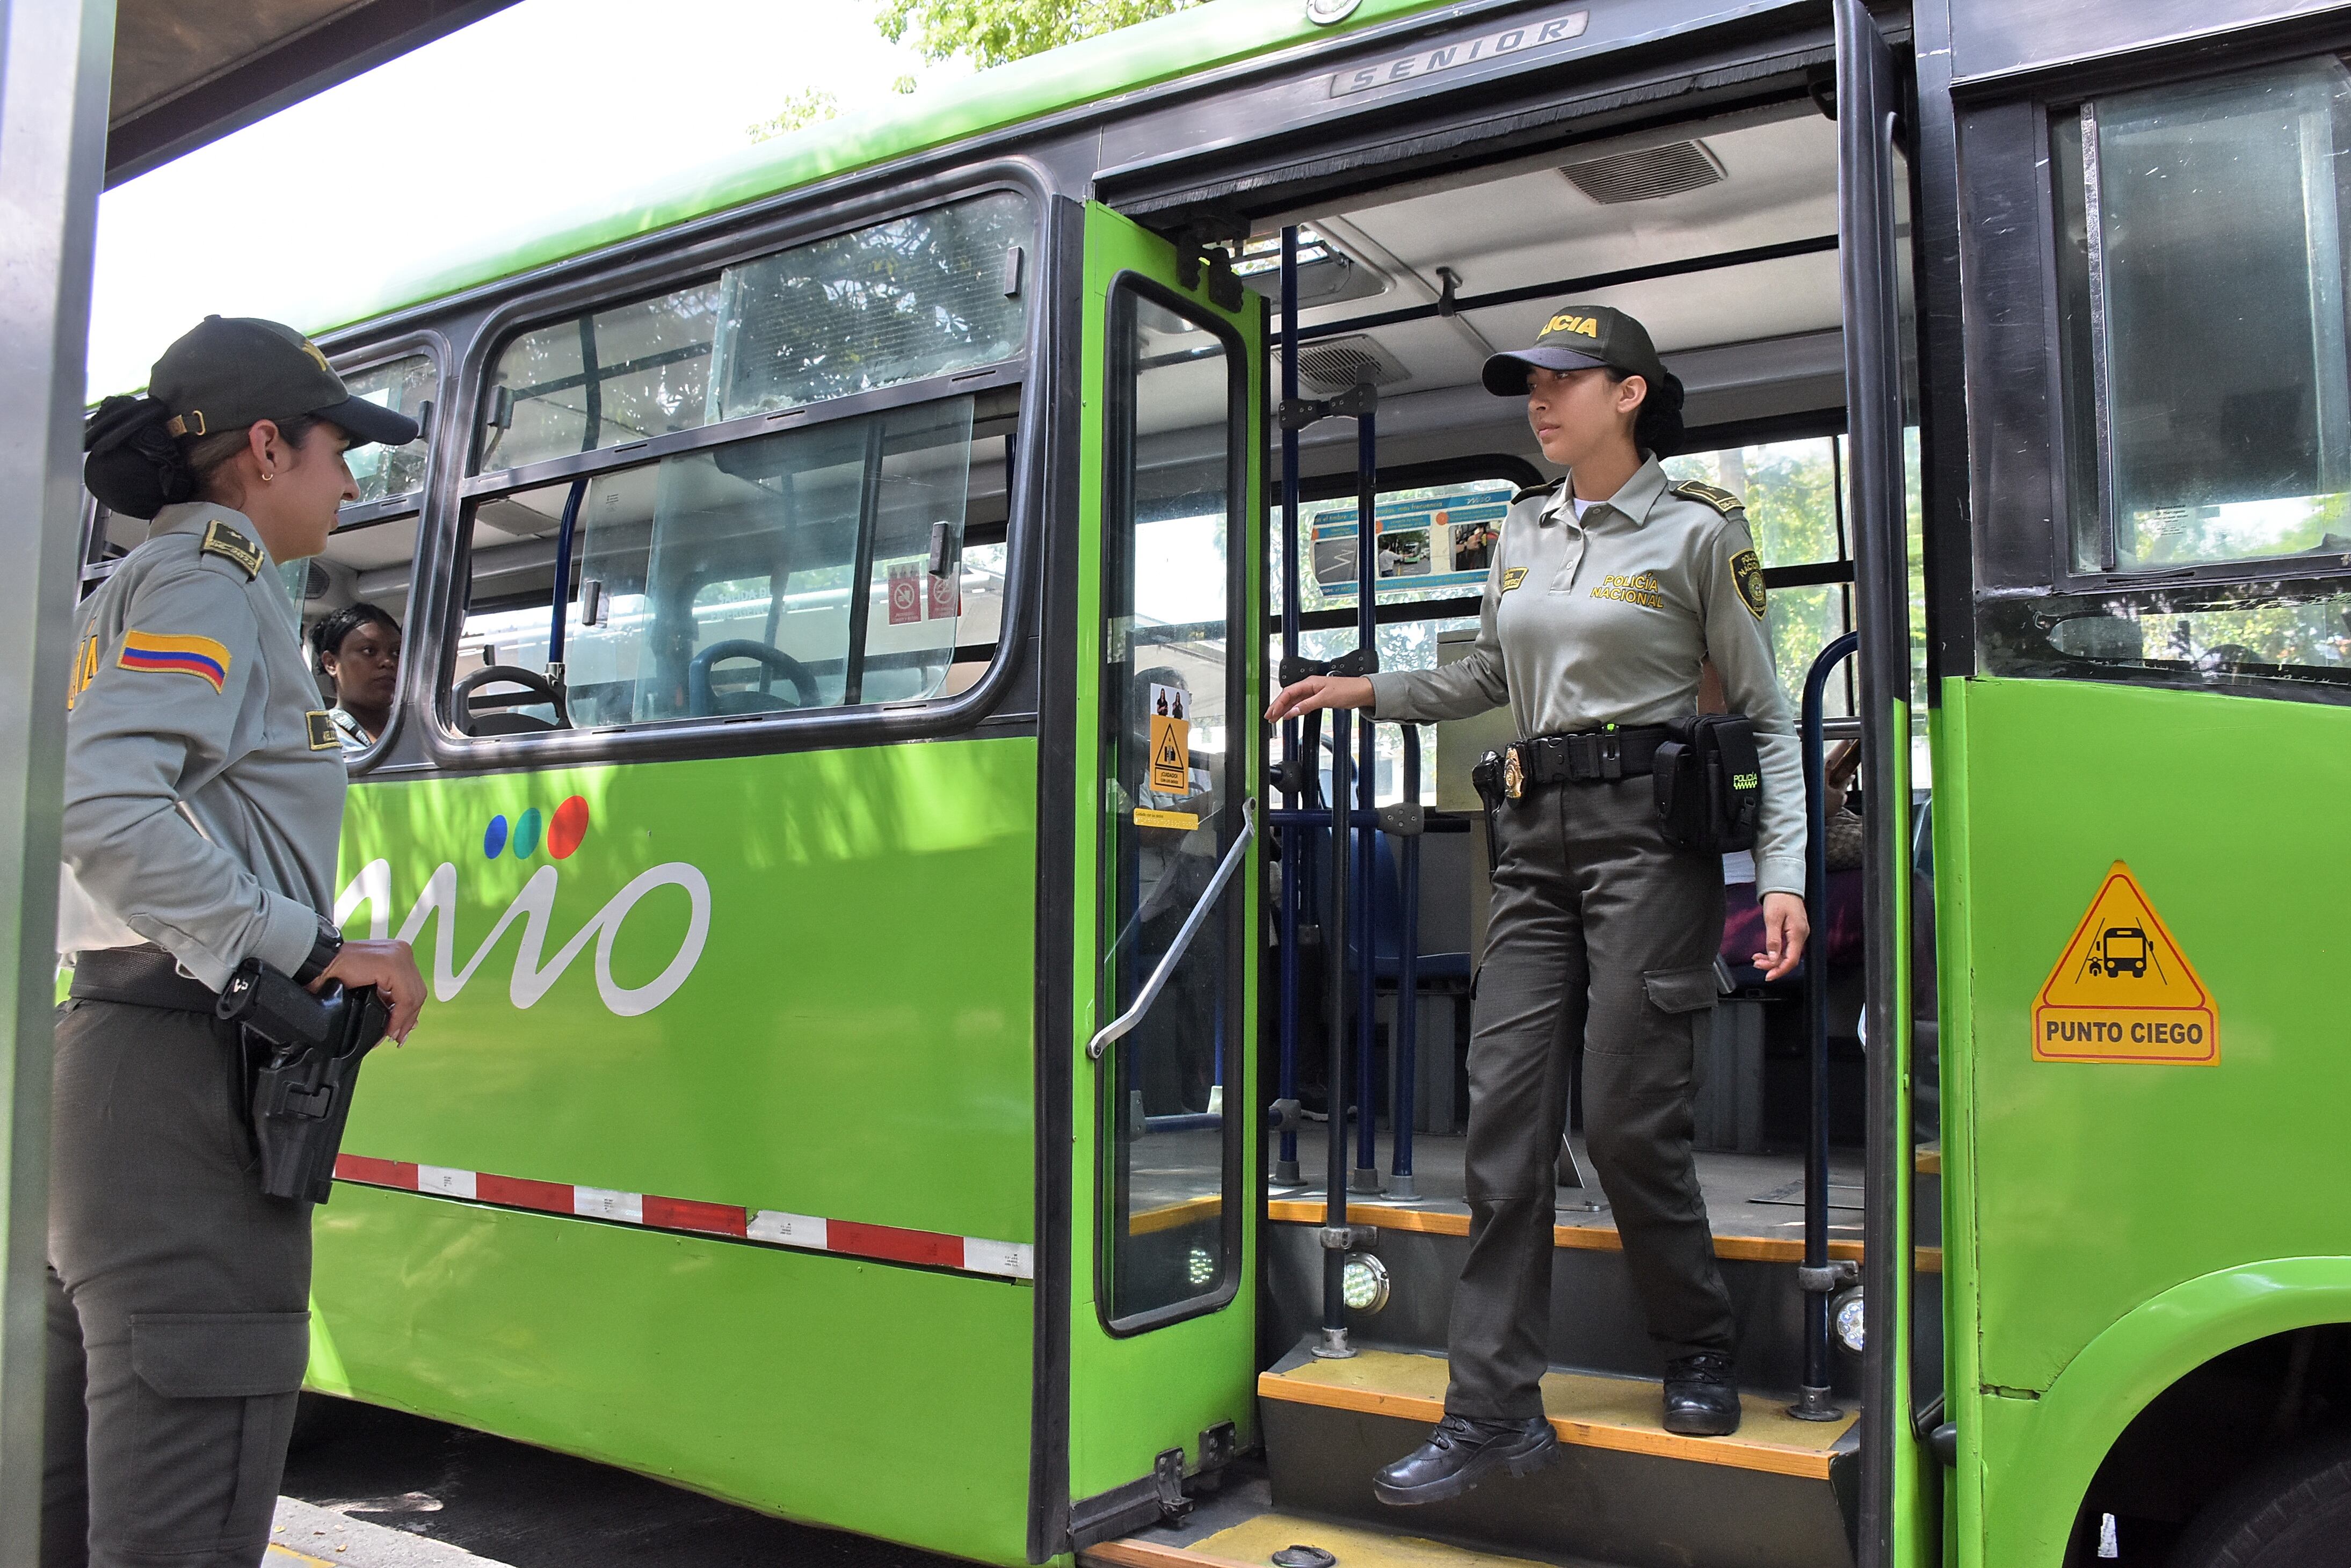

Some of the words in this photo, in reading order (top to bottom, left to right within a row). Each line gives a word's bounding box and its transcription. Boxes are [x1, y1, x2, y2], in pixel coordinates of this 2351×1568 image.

[1350, 19, 1568, 90] SENIOR
[1603, 572, 1658, 593] POLICÍA
[717, 589, 758, 604] SALIDA
[1590, 587, 1664, 608] NACIONAL
[1733, 771, 1757, 782] POLICÍA
[2046, 1020, 2123, 1042] PUNTO
[2130, 1022, 2203, 1044] CIEGO
